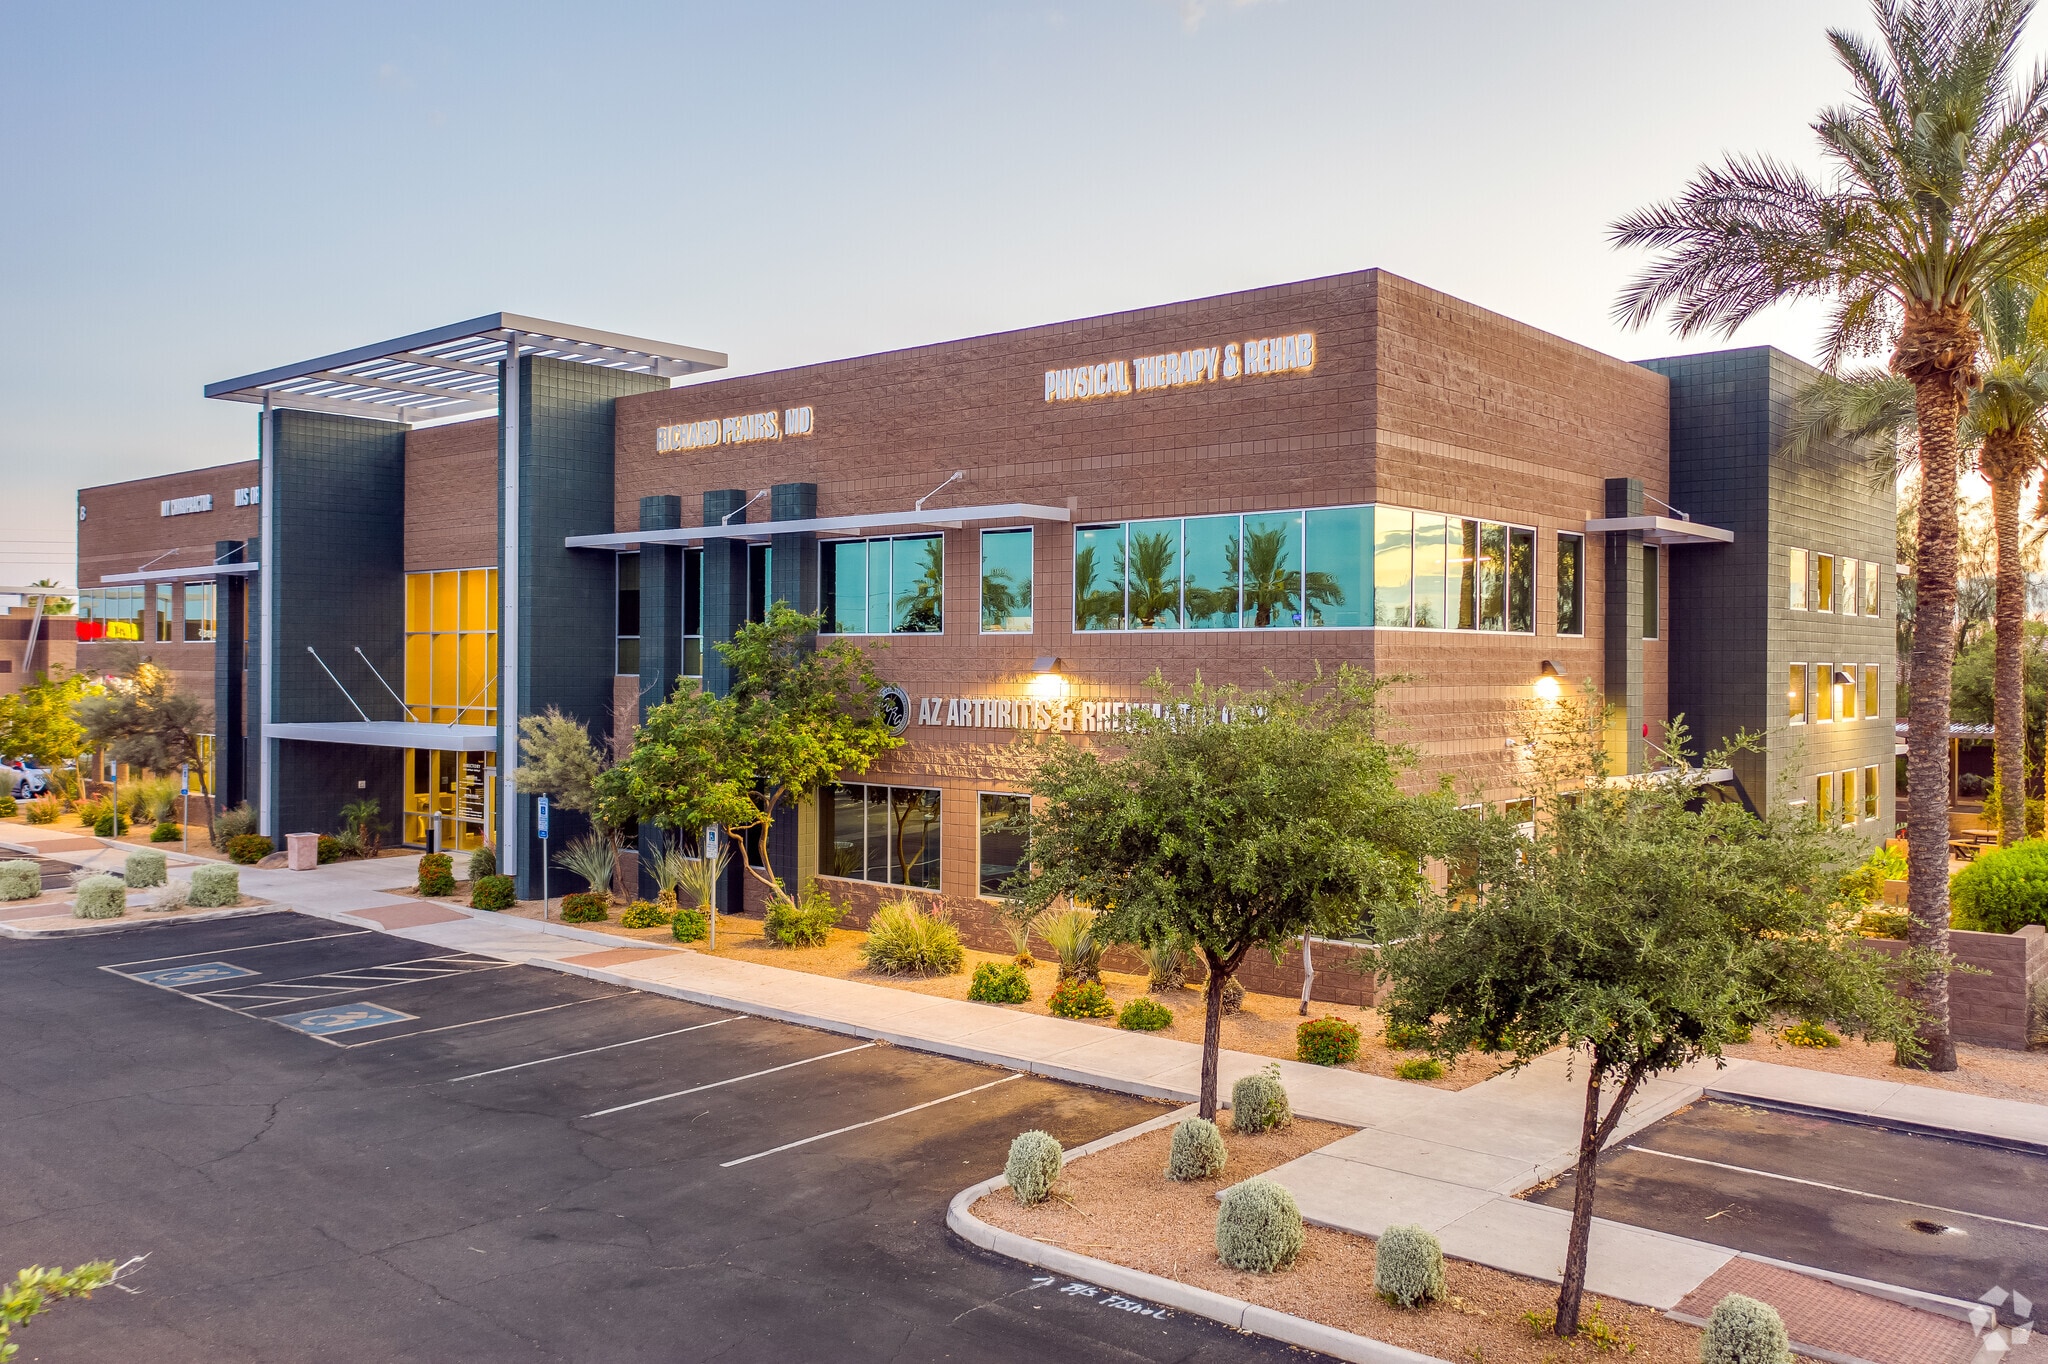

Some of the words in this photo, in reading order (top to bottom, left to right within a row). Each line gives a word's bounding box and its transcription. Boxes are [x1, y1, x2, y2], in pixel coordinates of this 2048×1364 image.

[1044, 361, 1128, 402] PHYSICAL
[1132, 347, 1218, 390] THERAPY
[1222, 344, 1239, 377] &
[1244, 333, 1313, 375] REHAB
[656, 420, 718, 452] RICHARD
[722, 411, 780, 443] PEAIRS,
[784, 407, 812, 435] MD
[917, 697, 943, 726] AZ
[946, 698, 1052, 731] ARTHRITIS
[1057, 701, 1076, 731] &
